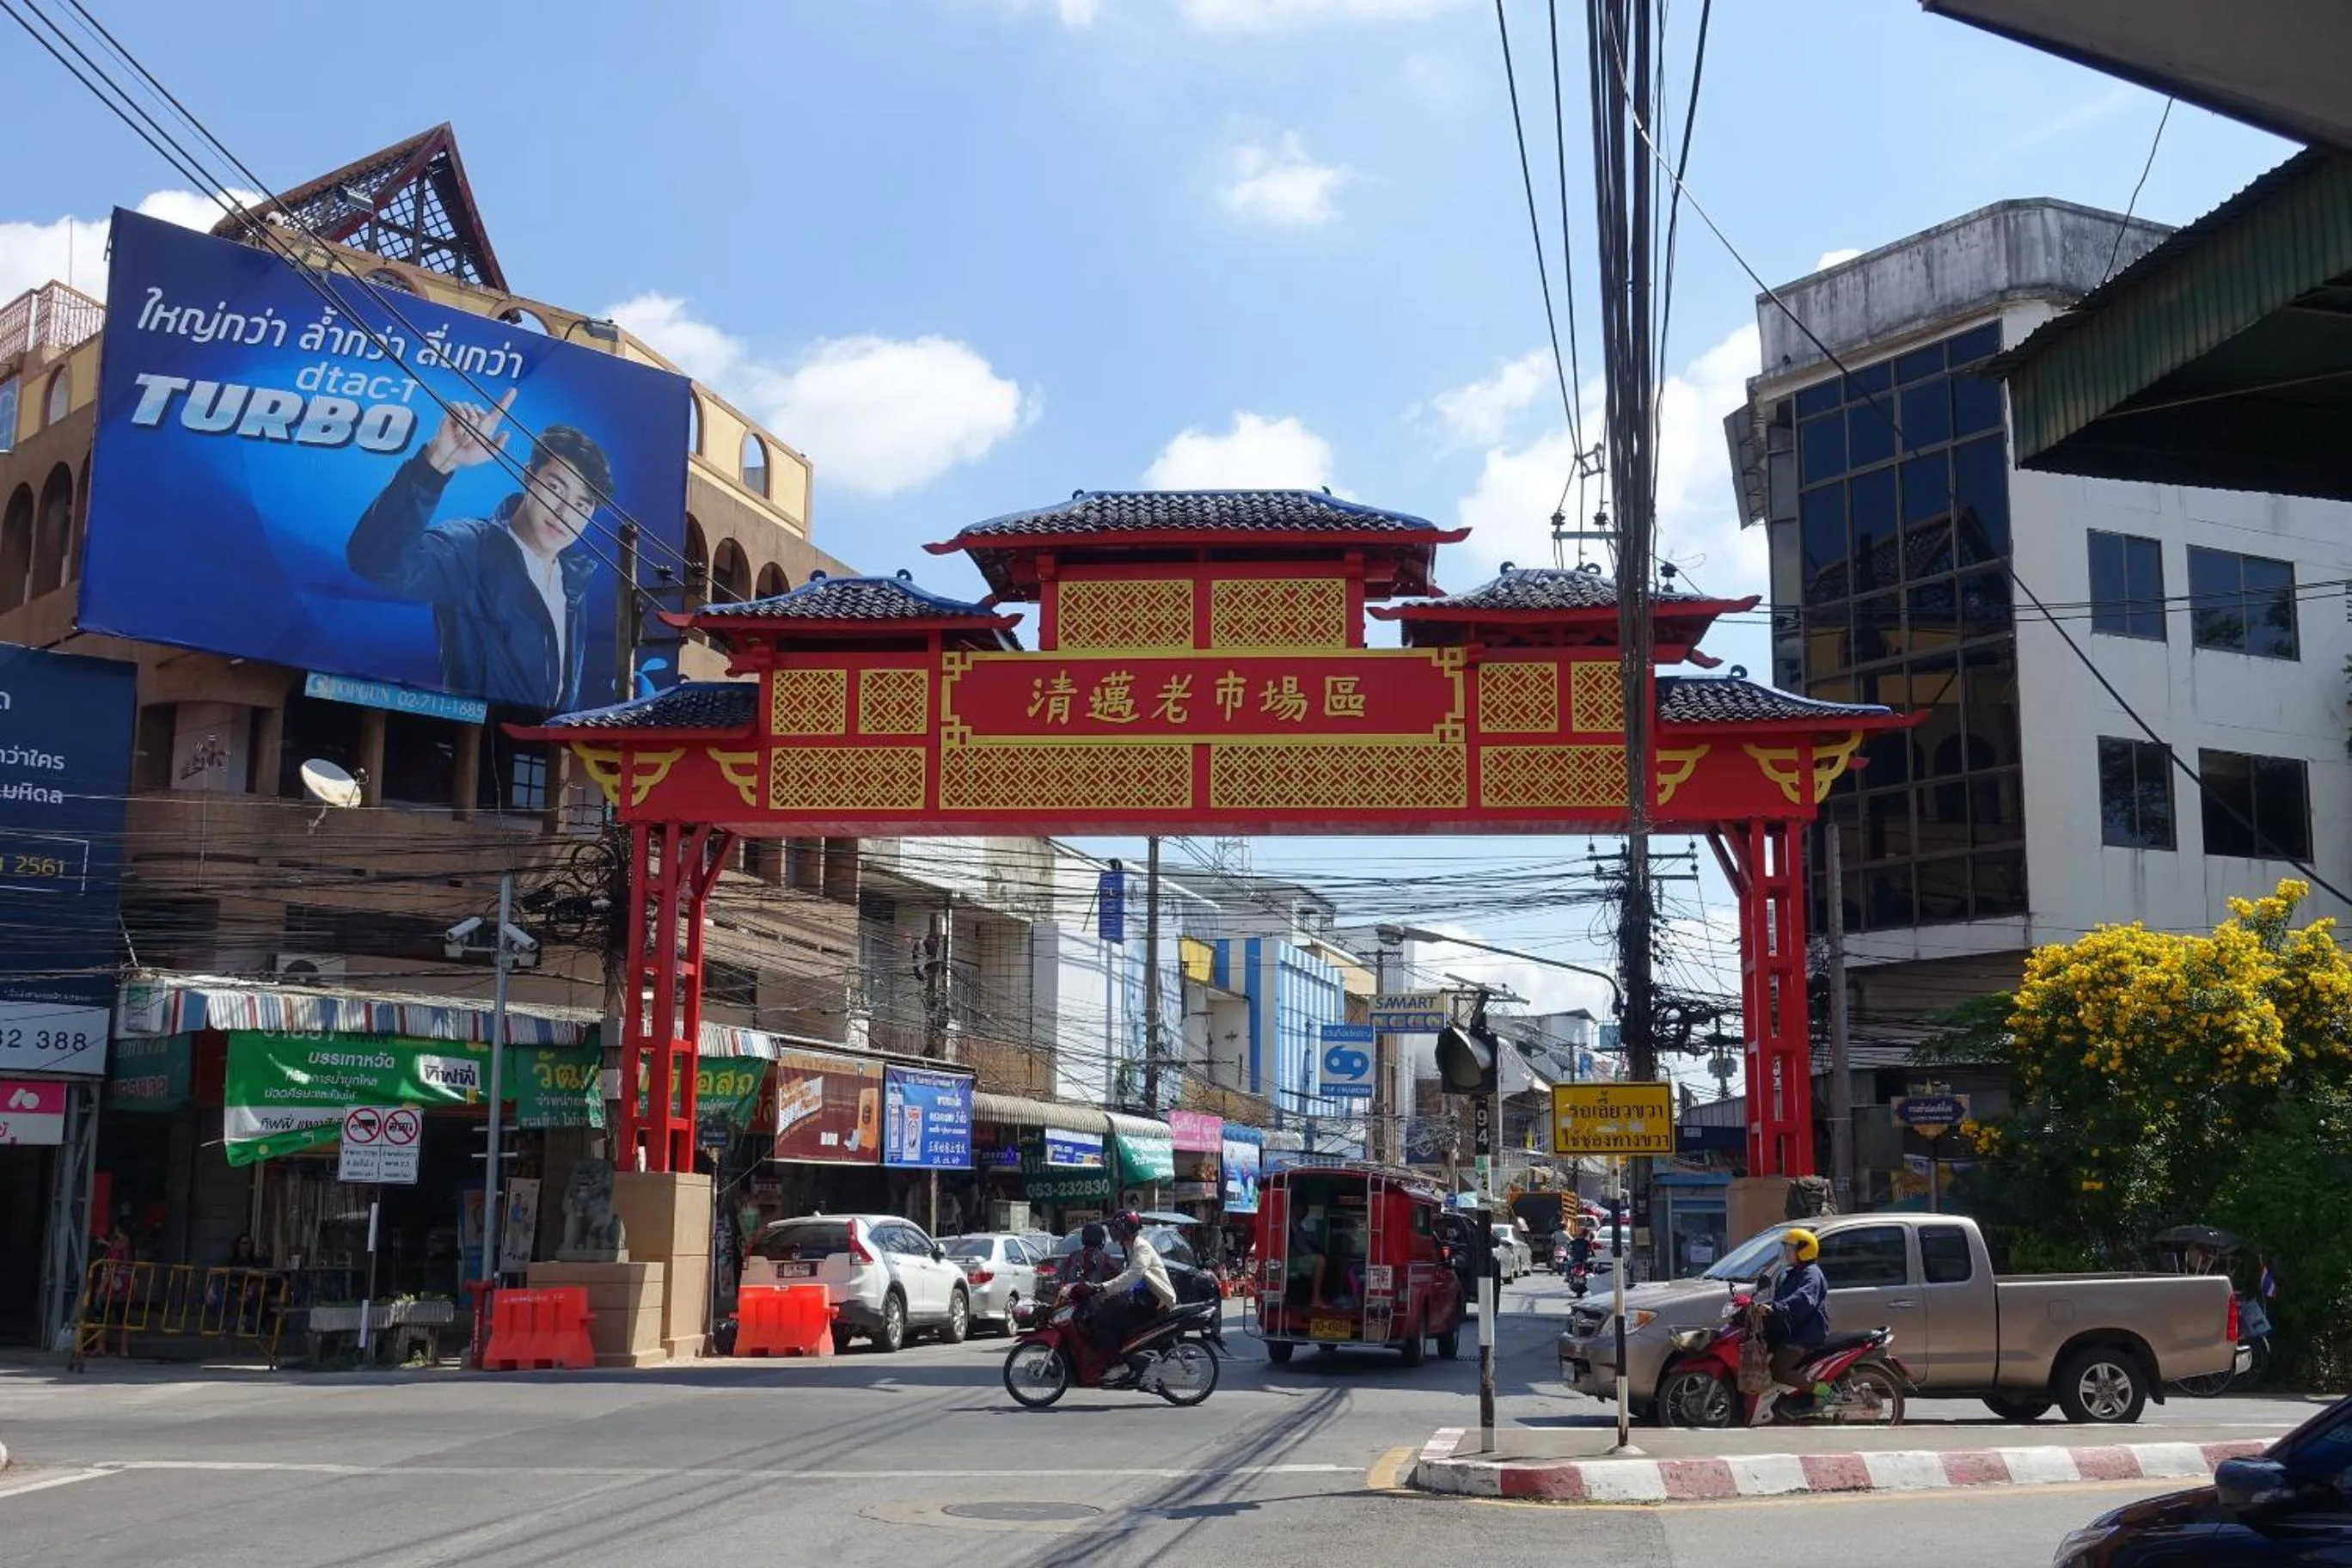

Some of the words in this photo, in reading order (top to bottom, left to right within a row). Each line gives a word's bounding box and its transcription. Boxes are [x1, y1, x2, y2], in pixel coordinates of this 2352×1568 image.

[138, 286, 288, 347] ใหญ่กว่า
[298, 305, 406, 361] ล้ำกว่า
[415, 323, 524, 379] ลื่นกว่า
[296, 361, 418, 403] dtac-T
[132, 373, 416, 453] TURBO
[1026, 669, 1367, 726] 清邁老市場區
[15, 855, 64, 877] 2561
[0, 1028, 22, 1049] 2
[36, 1031, 88, 1052] 388
[308, 1050, 396, 1069] บรรเทาหวัด
[1569, 1089, 1663, 1118] รถเลี้ยวขวา
[1561, 1127, 1669, 1149] ใช้ช่องทางขวา
[1026, 1179, 1111, 1199] 053-232830
